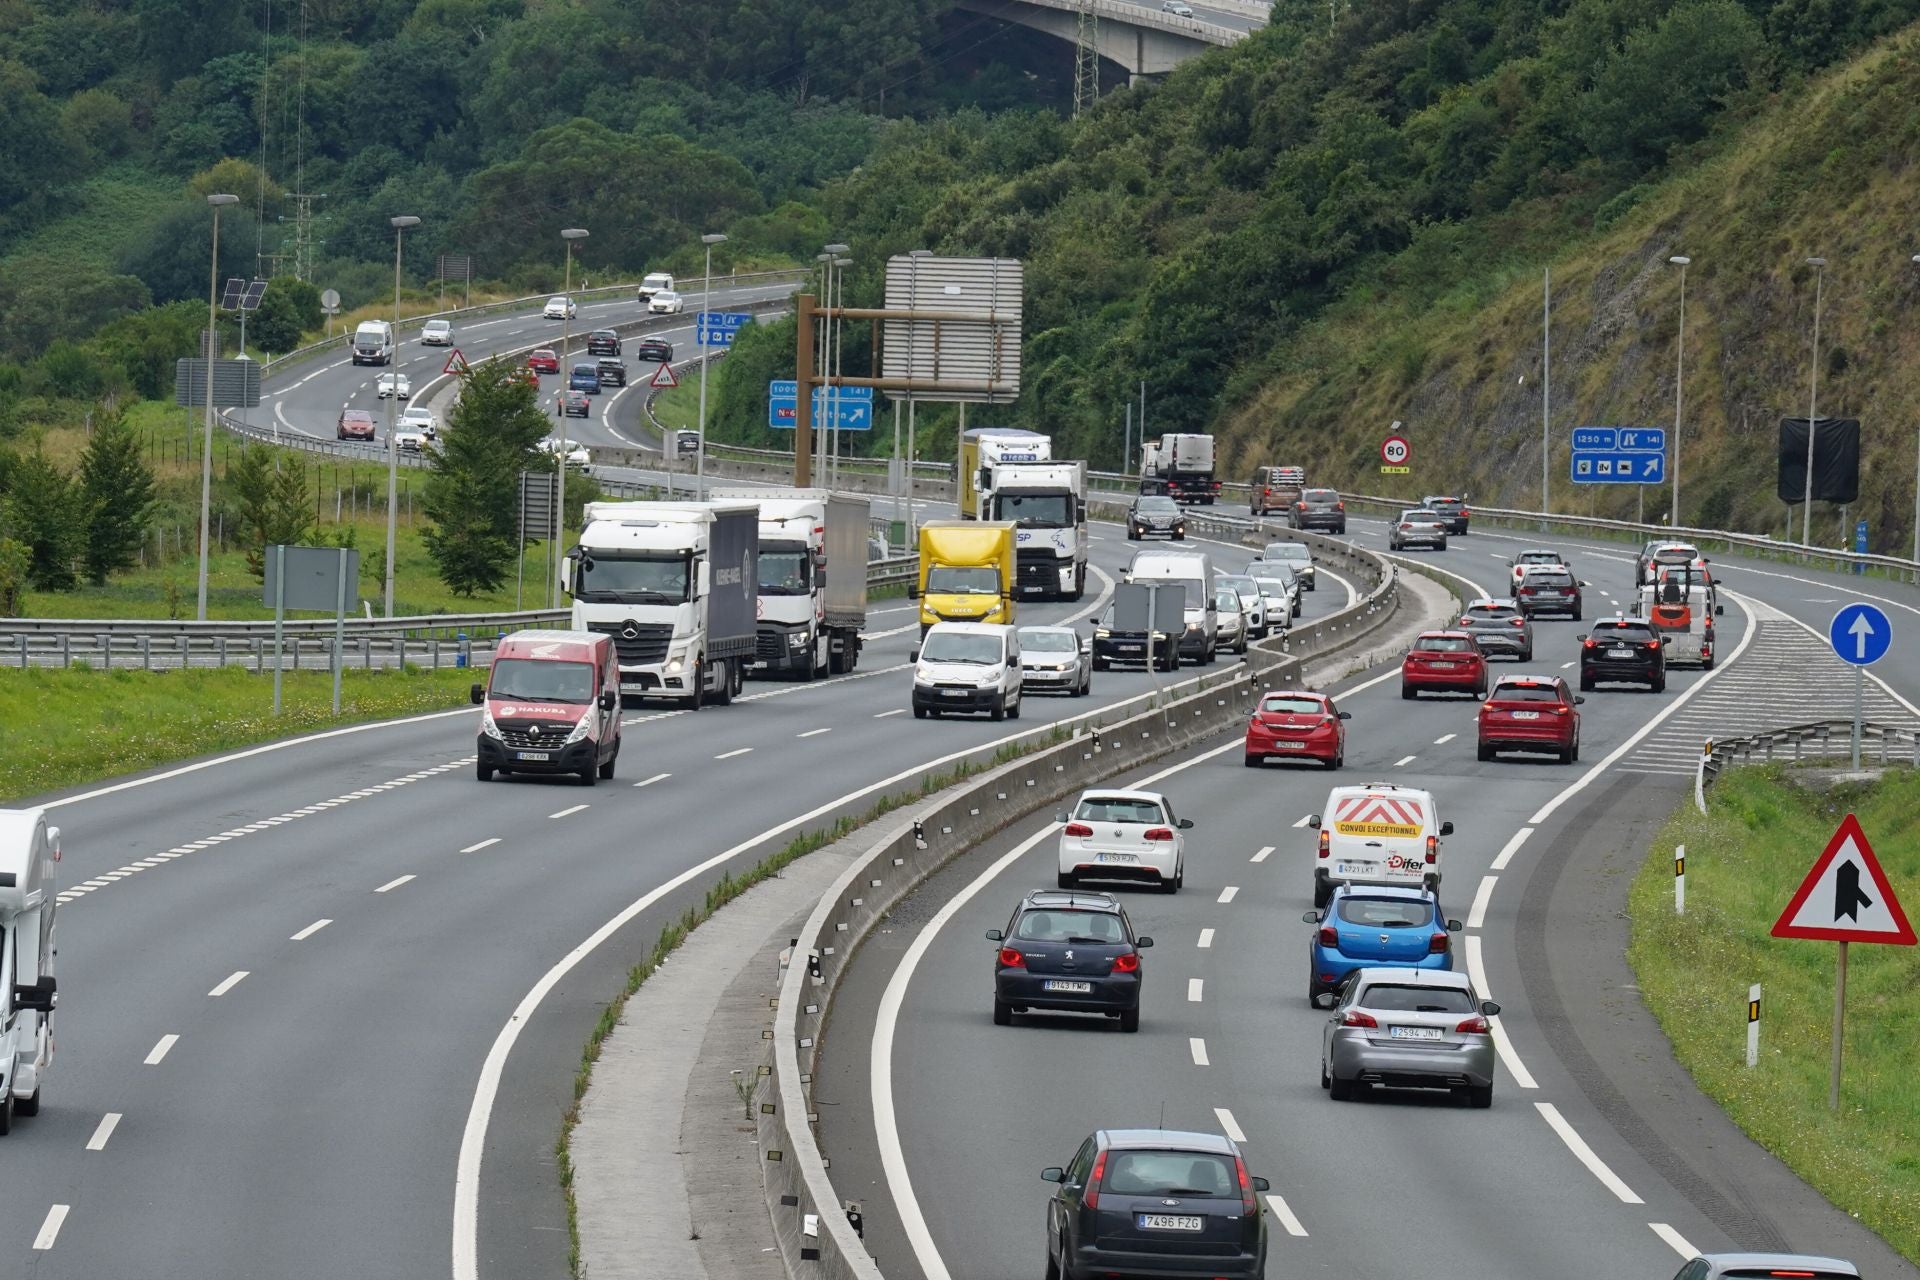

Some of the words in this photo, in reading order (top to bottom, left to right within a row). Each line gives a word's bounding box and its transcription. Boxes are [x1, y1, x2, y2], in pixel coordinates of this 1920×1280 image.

[773, 385, 798, 393] 1000
[778, 408, 797, 418] N-6
[814, 411, 847, 420] Otn
[1577, 435, 1600, 444] 1250
[1646, 435, 1660, 444] 141
[1387, 446, 1404, 456] 80
[1017, 533, 1032, 542] SP
[518, 706, 567, 715] HAKUBA
[1340, 823, 1366, 833] CONVOI
[1367, 825, 1417, 836] EXCEPTIONNEL
[1386, 855, 1425, 870] Difer
[1051, 981, 1070, 990] 9143
[1072, 982, 1088, 991] FMG
[1398, 1028, 1420, 1037] 2594
[1422, 1029, 1439, 1038] JNT
[1146, 1216, 1175, 1228] 7496
[1177, 1217, 1199, 1229] FZG
